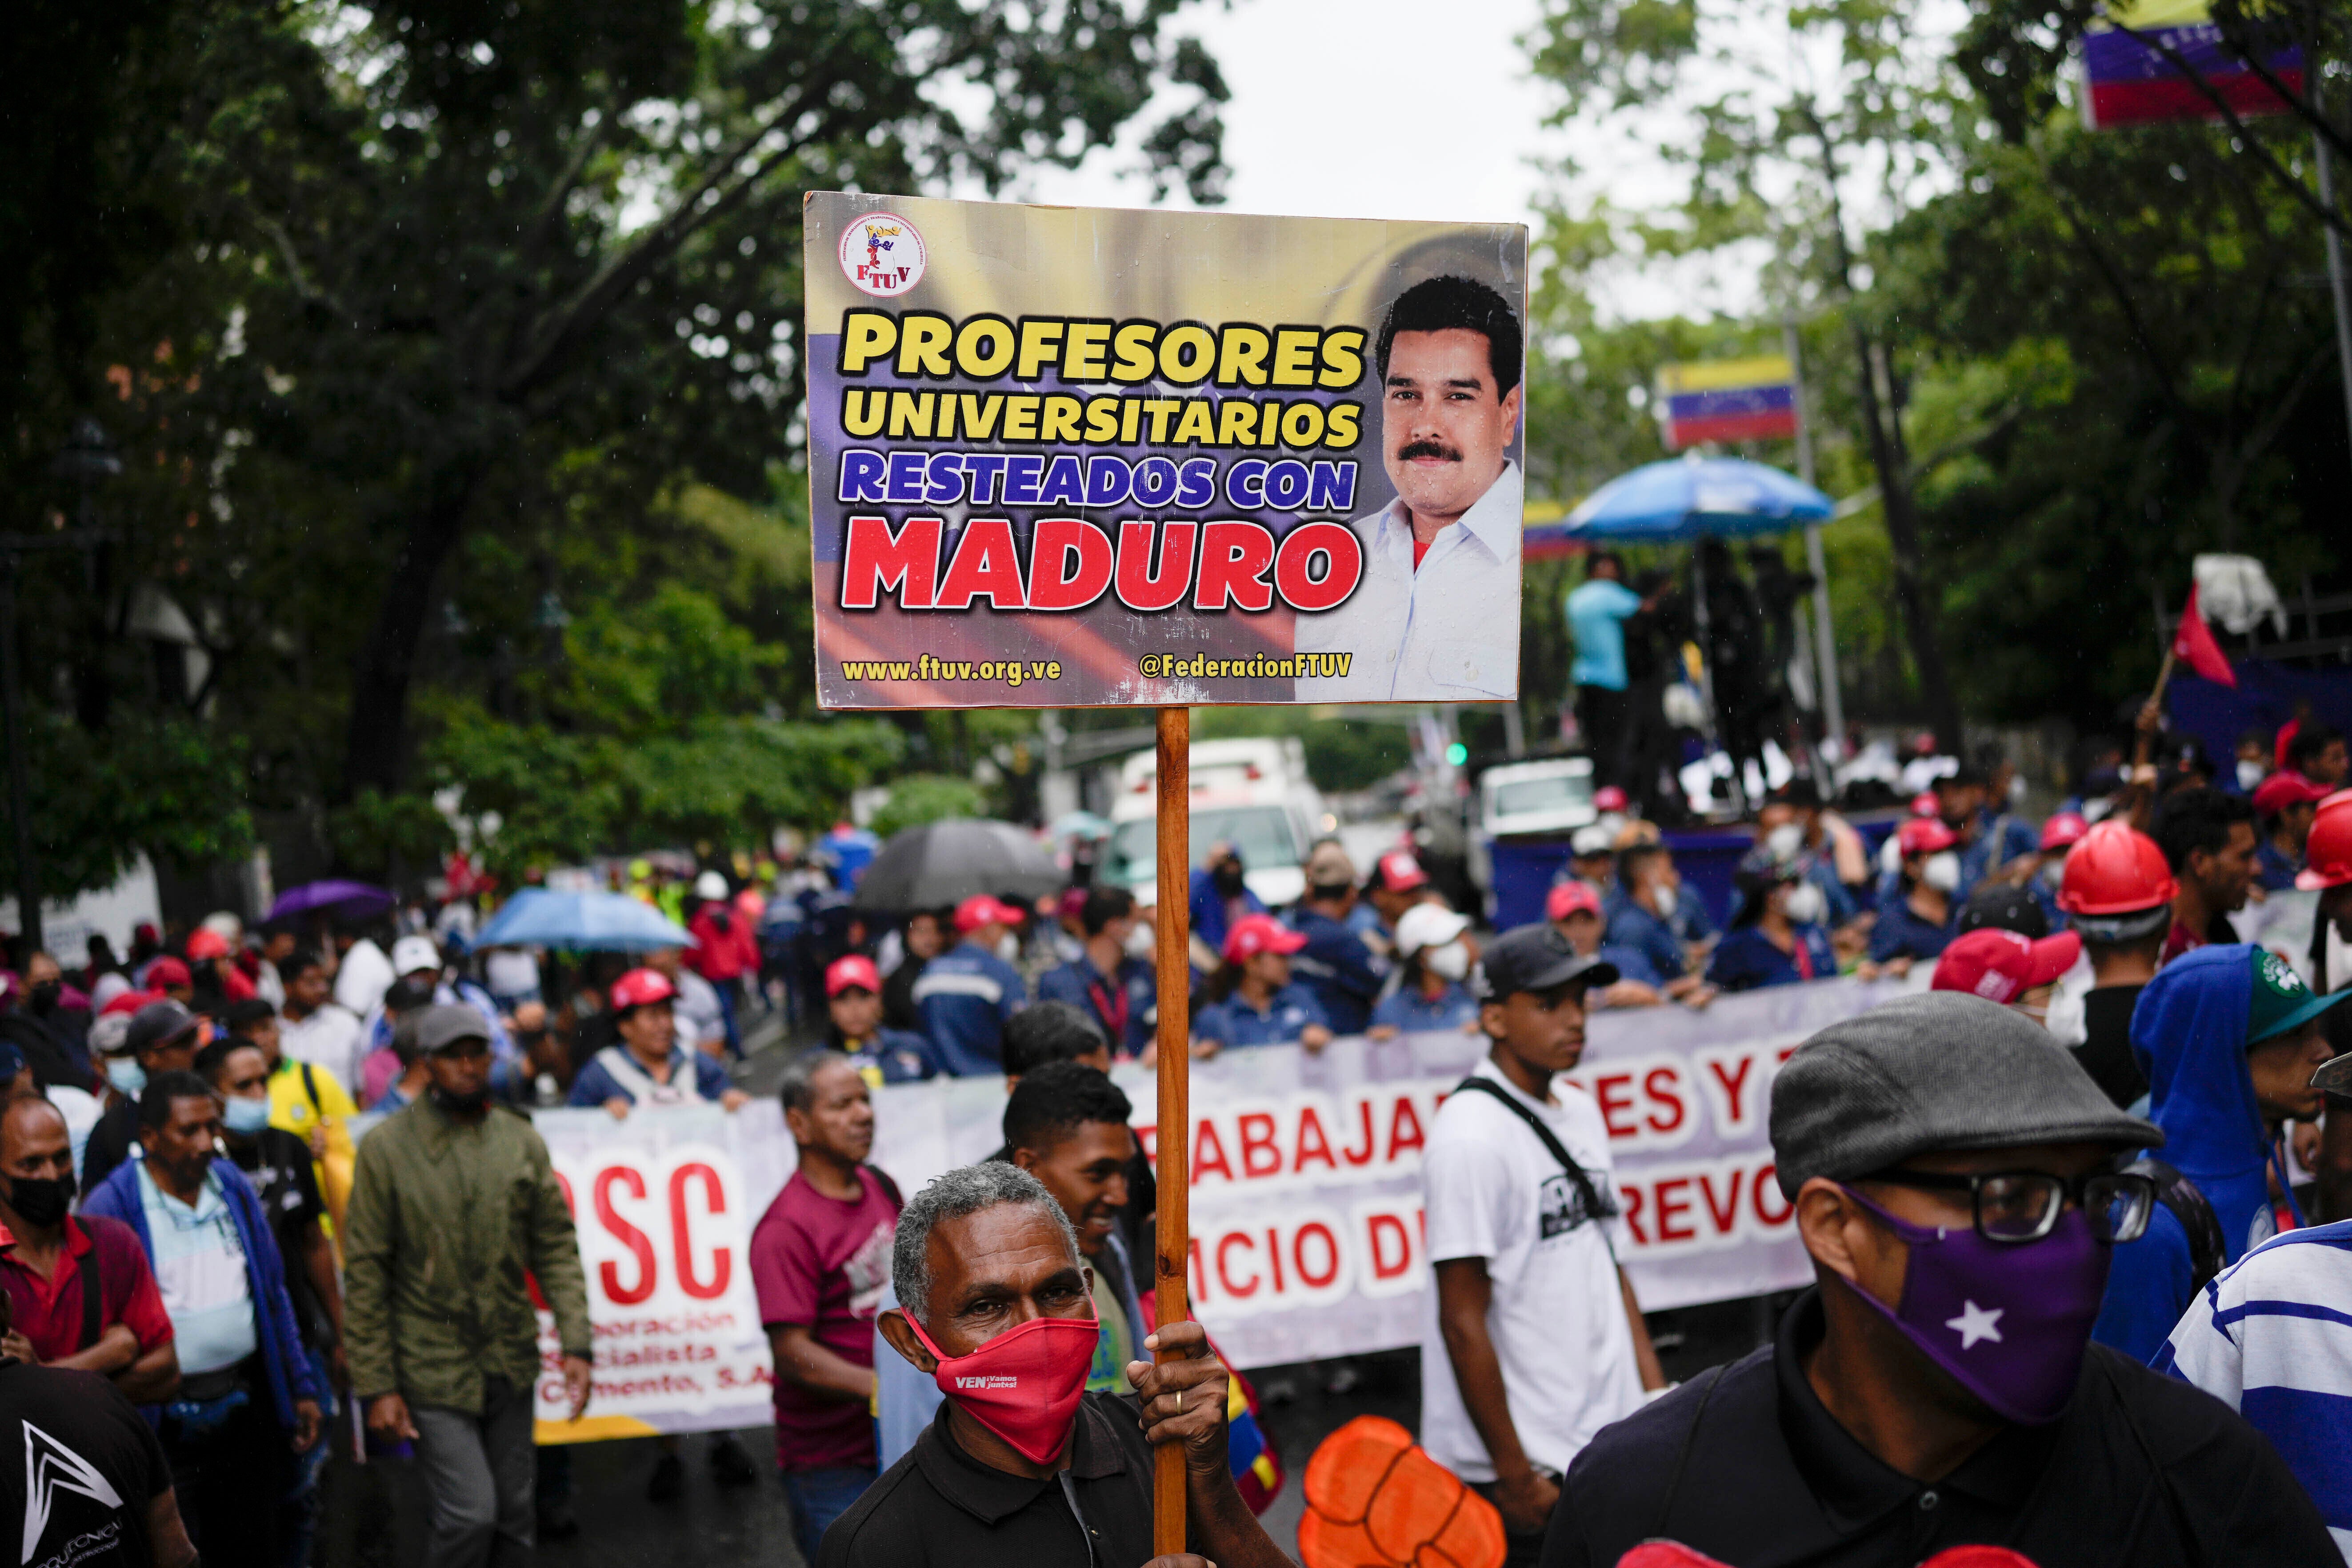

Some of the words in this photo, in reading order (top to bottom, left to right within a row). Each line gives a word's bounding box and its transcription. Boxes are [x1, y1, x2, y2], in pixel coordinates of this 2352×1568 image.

[857, 265, 910, 288] FTUV
[843, 313, 1364, 388] PROFESORES
[844, 390, 1361, 448] UNIVERSITARIOS
[838, 449, 1217, 509] RESTEADOS
[1225, 458, 1358, 510] CON
[841, 516, 1363, 611] MADURO
[841, 653, 1062, 687] www.ftuv.org.ve
[1138, 651, 1353, 678] @FederacionFTUV
[1708, 1055, 1753, 1123] Y
[524, 1162, 732, 1309] SC
[1188, 1222, 1339, 1304] ICIO
[955, 1376, 987, 1388] VEN
